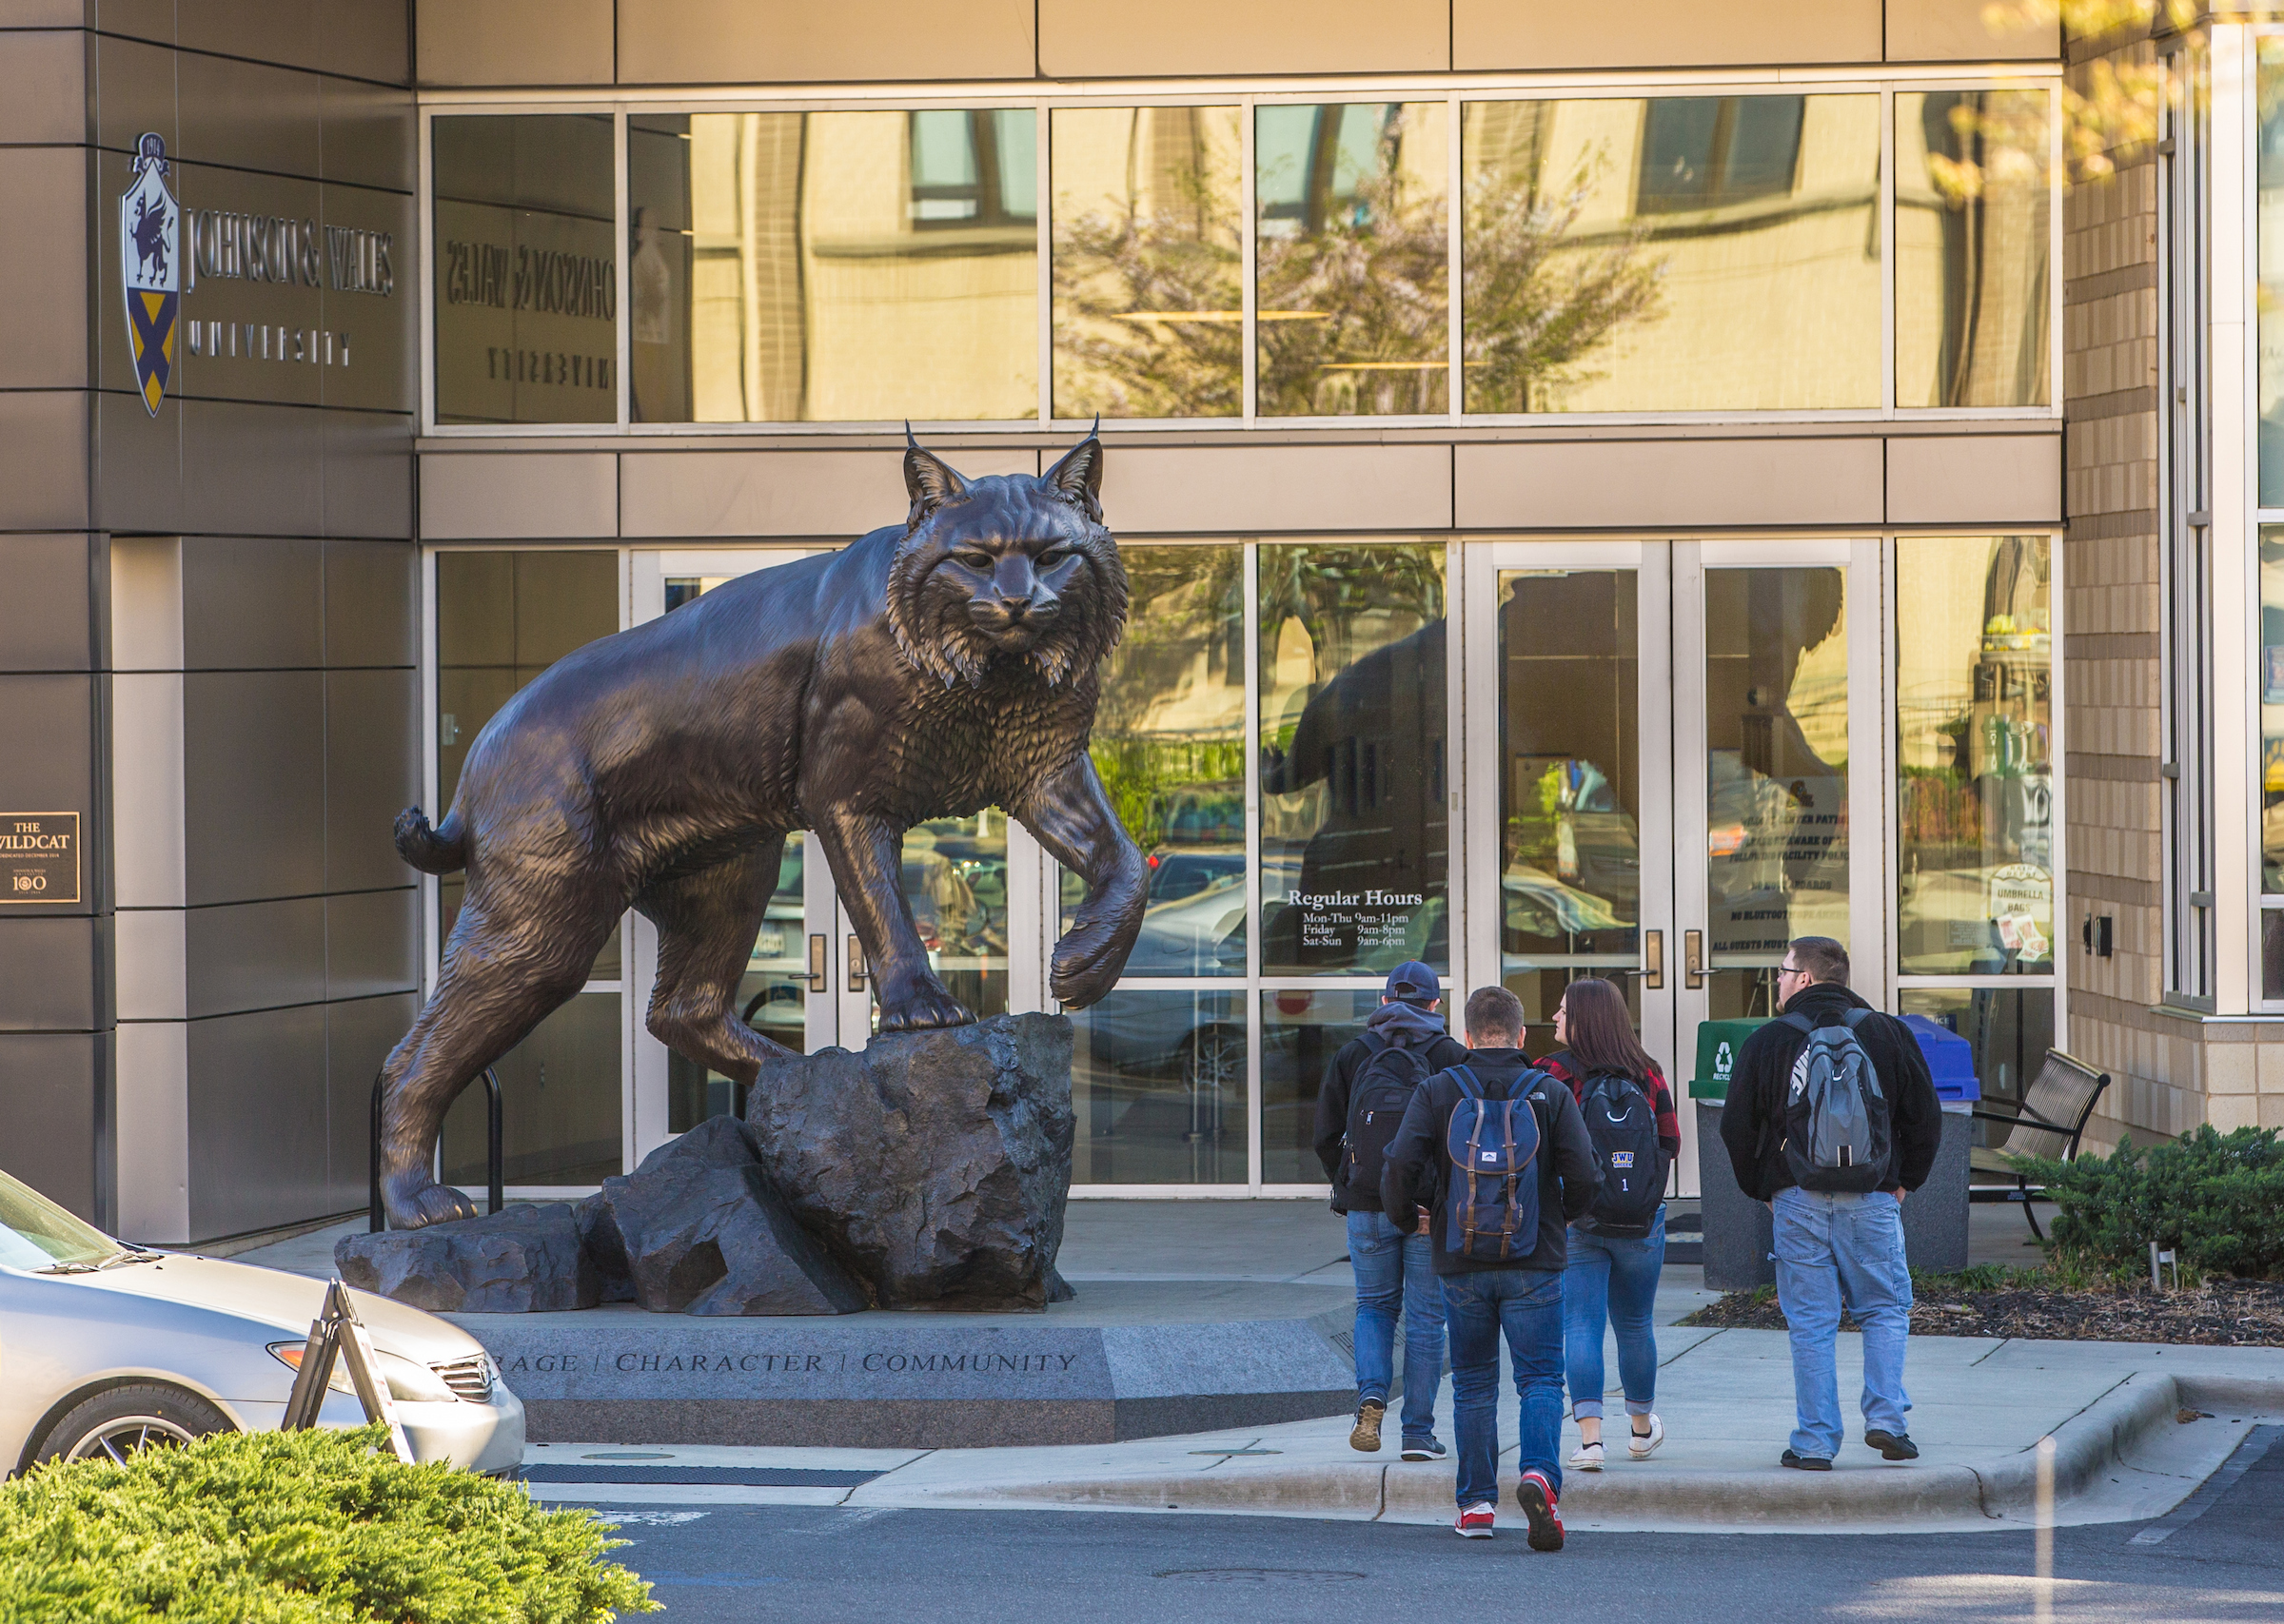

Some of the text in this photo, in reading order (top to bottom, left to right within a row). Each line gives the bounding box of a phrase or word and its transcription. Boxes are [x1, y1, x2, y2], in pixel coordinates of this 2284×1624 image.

[186, 207, 393, 297] JOHNSON & WALES
[189, 320, 350, 366] UNIVERSITY
[13, 822, 41, 833] THE
[1288, 890, 1423, 910] Regular Hours
[1997, 889, 2044, 900] UMBRELLA
[1303, 911, 1409, 926] Mon-Thu 9am-11pm
[1303, 924, 1406, 937] Friday 9am-8pm
[1303, 935, 1406, 949] Sat-Sun 9am-6pm
[1713, 1072, 1732, 1081] RECYCL
[1612, 1152, 1633, 1163] JWU
[1622, 1178, 1629, 1191] 1
[493, 1353, 1078, 1372] RAGE CHARACTER COMMUNITY
